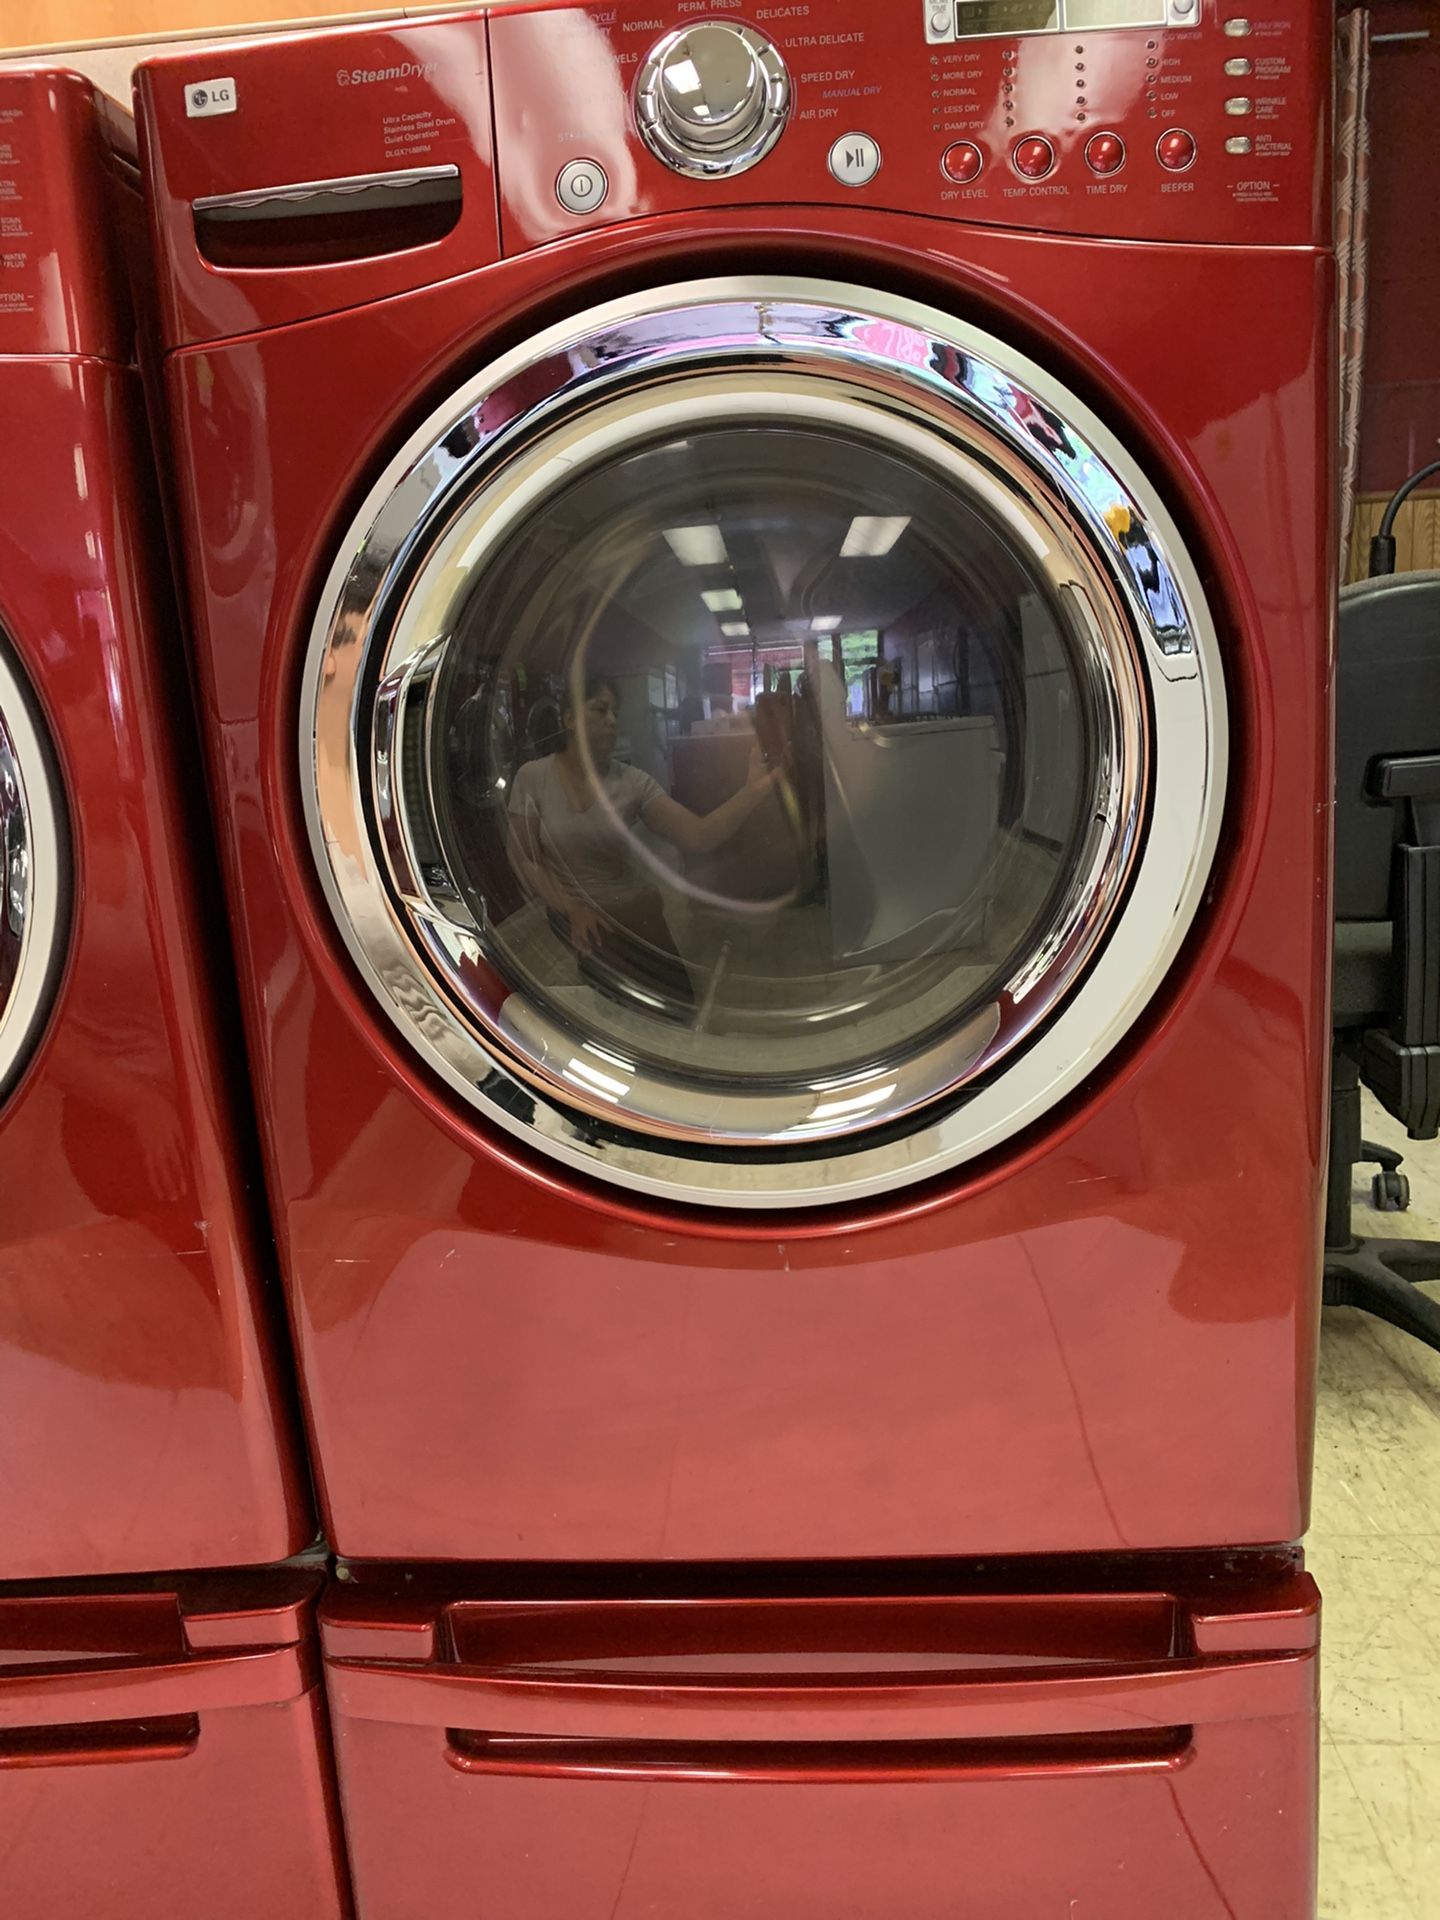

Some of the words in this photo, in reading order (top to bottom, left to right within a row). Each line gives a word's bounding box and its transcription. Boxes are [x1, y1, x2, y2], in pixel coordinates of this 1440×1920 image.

[710, 0, 742, 8] PRESS
[756, 5, 810, 19] DELICATES
[622, 20, 664, 32] NORMAL
[785, 36, 817, 48] ULTRA
[819, 32, 865, 45] DELICATE
[943, 55, 962, 63] VERY
[964, 54, 981, 62] DRY
[351, 62, 439, 85] SteamDryer
[800, 71, 833, 84] SPEED
[835, 69, 856, 81] DRY
[943, 72, 965, 80] MORE
[967, 70, 983, 79] DRY
[1161, 75, 1193, 84] MEDIUM
[211, 88, 230, 102] LG
[822, 88, 862, 99] MANUAL
[863, 85, 882, 96] DRY
[943, 87, 977, 97] NORMAL
[1161, 92, 1179, 101] LOW
[799, 110, 817, 120] AIR
[818, 107, 839, 119] DRY
[944, 105, 964, 114] LESS
[965, 104, 981, 113] DRY
[1161, 109, 1176, 118] OFF
[382, 116, 400, 125] Ultra
[401, 111, 432, 122] Capacity
[383, 124, 415, 135] Stainless
[416, 119, 434, 130] Steel
[435, 117, 456, 128] Drum
[944, 122, 968, 131] DAMP
[968, 121, 985, 130] DRY
[384, 135, 404, 145] Quiet
[404, 130, 440, 142] Operation
[1029, 185, 1070, 197] CONTROL
[1086, 184, 1106, 195] TIME
[1108, 183, 1128, 195] DRY
[1161, 182, 1195, 193] BEEPER
[1236, 181, 1271, 191] OPTION
[941, 191, 959, 201] DRY
[960, 189, 989, 200] LEVEL
